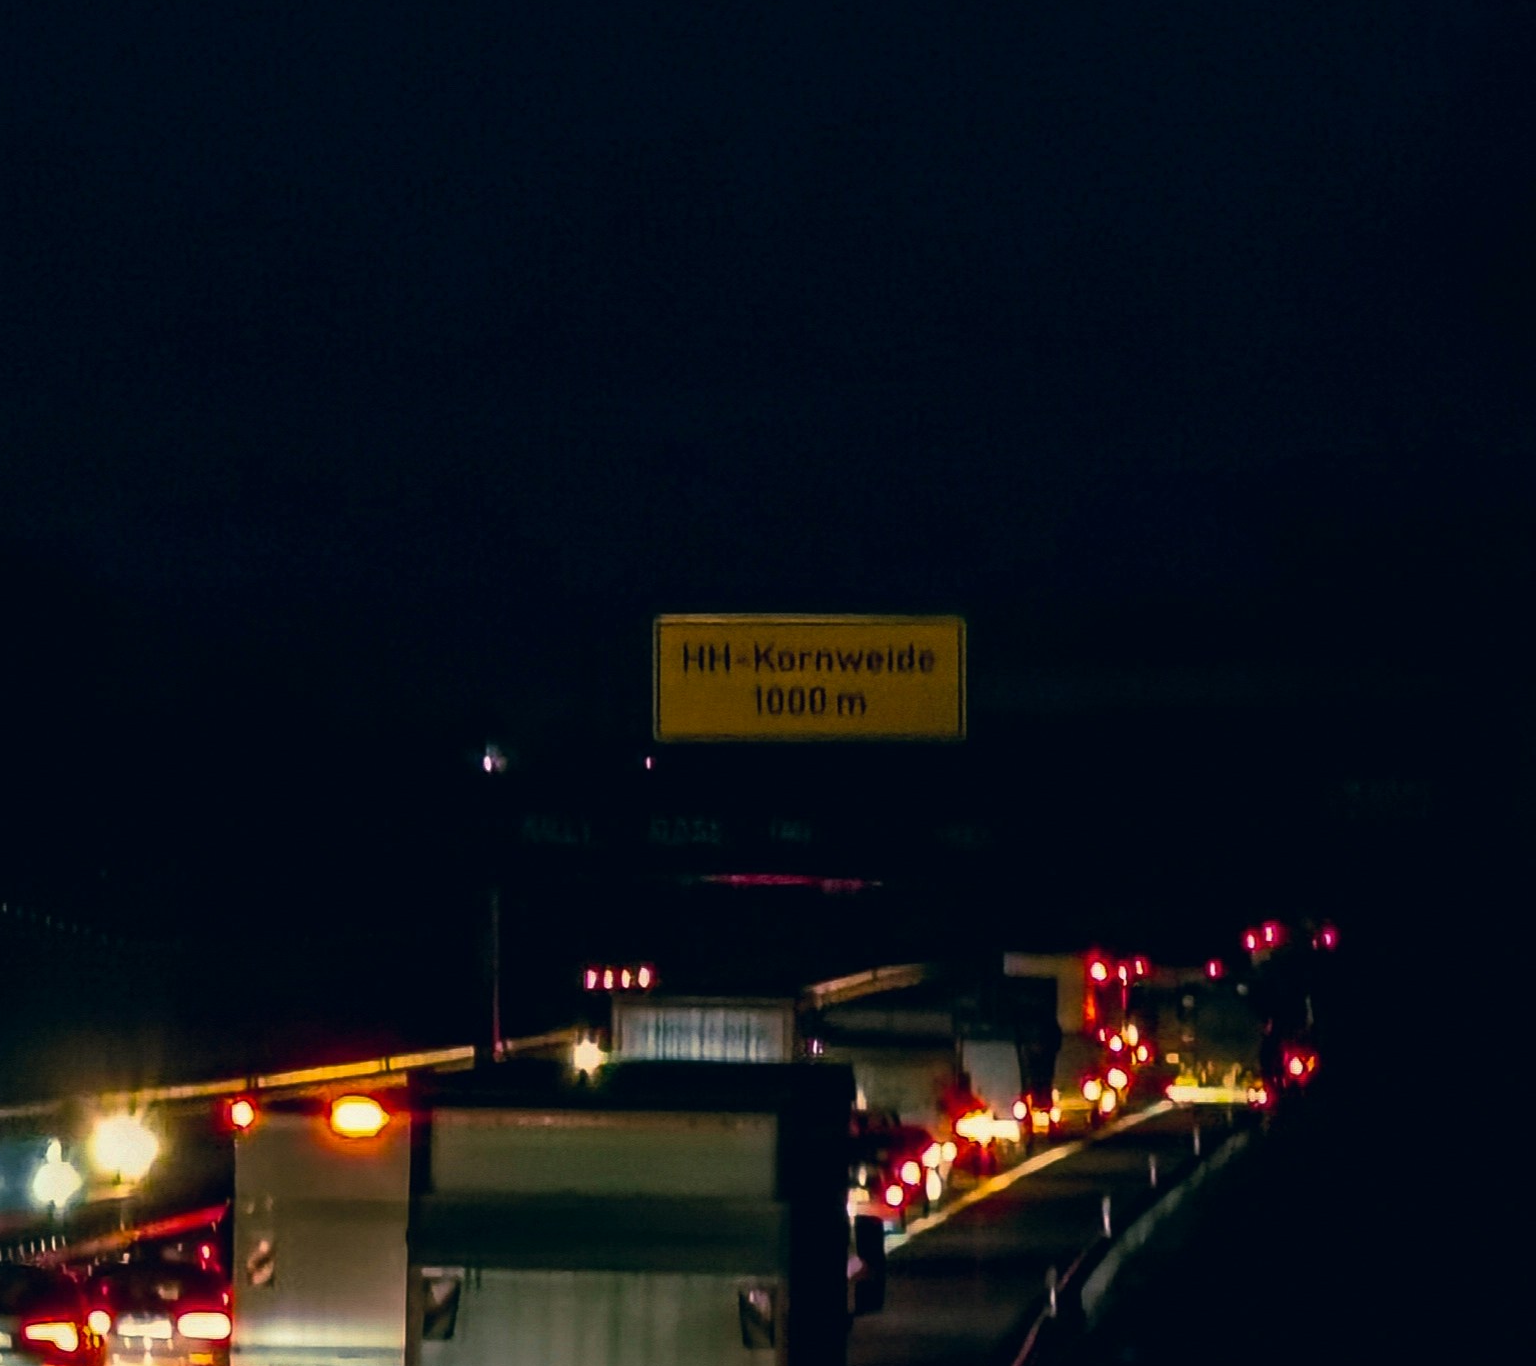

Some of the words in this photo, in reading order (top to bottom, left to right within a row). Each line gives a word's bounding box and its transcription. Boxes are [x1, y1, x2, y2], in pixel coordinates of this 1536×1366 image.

[682, 641, 936, 674] HH-Kornweide
[755, 685, 827, 716] 1000
[836, 691, 867, 716] m
